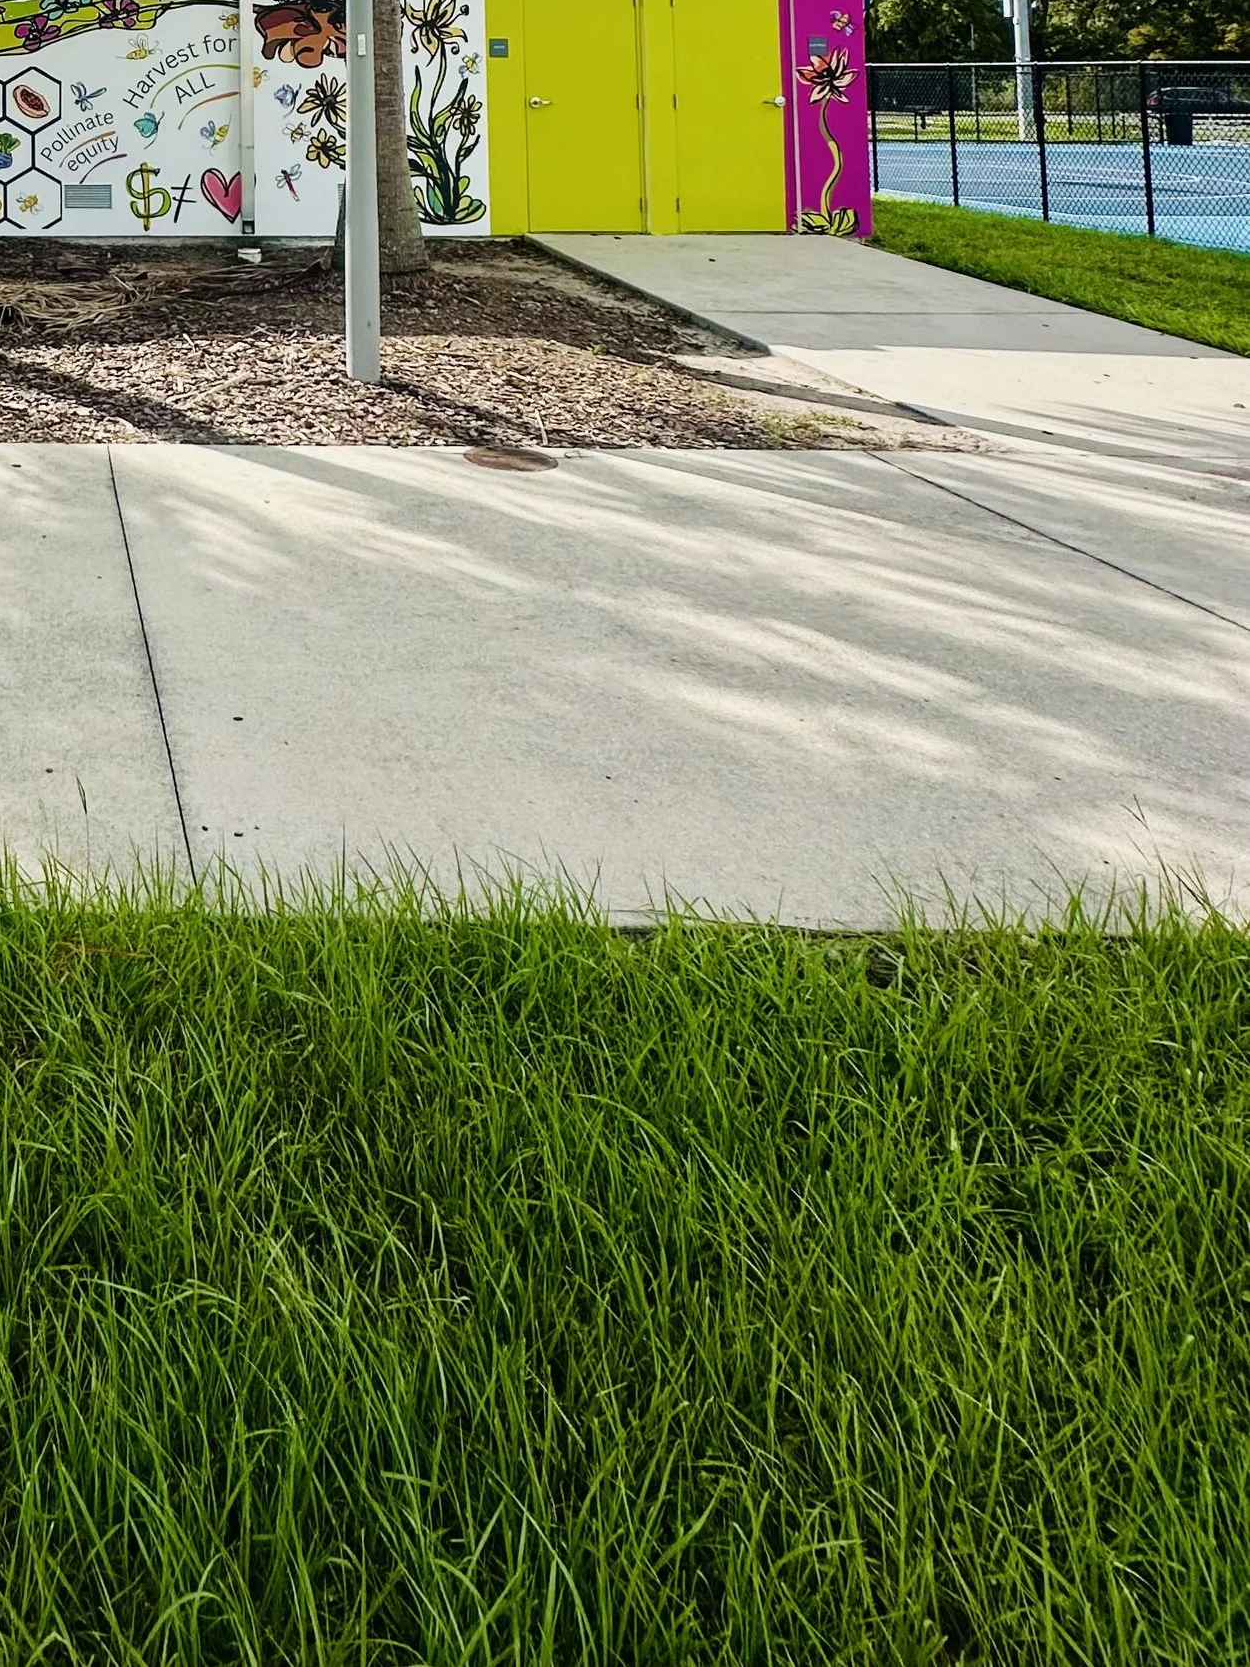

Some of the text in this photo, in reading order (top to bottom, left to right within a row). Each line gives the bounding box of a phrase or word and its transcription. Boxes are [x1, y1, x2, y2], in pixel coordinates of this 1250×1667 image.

[122, 34, 238, 109] Harvest for
[174, 72, 216, 104] ALL
[40, 112, 114, 162] Pollinate
[67, 135, 119, 172] equity
